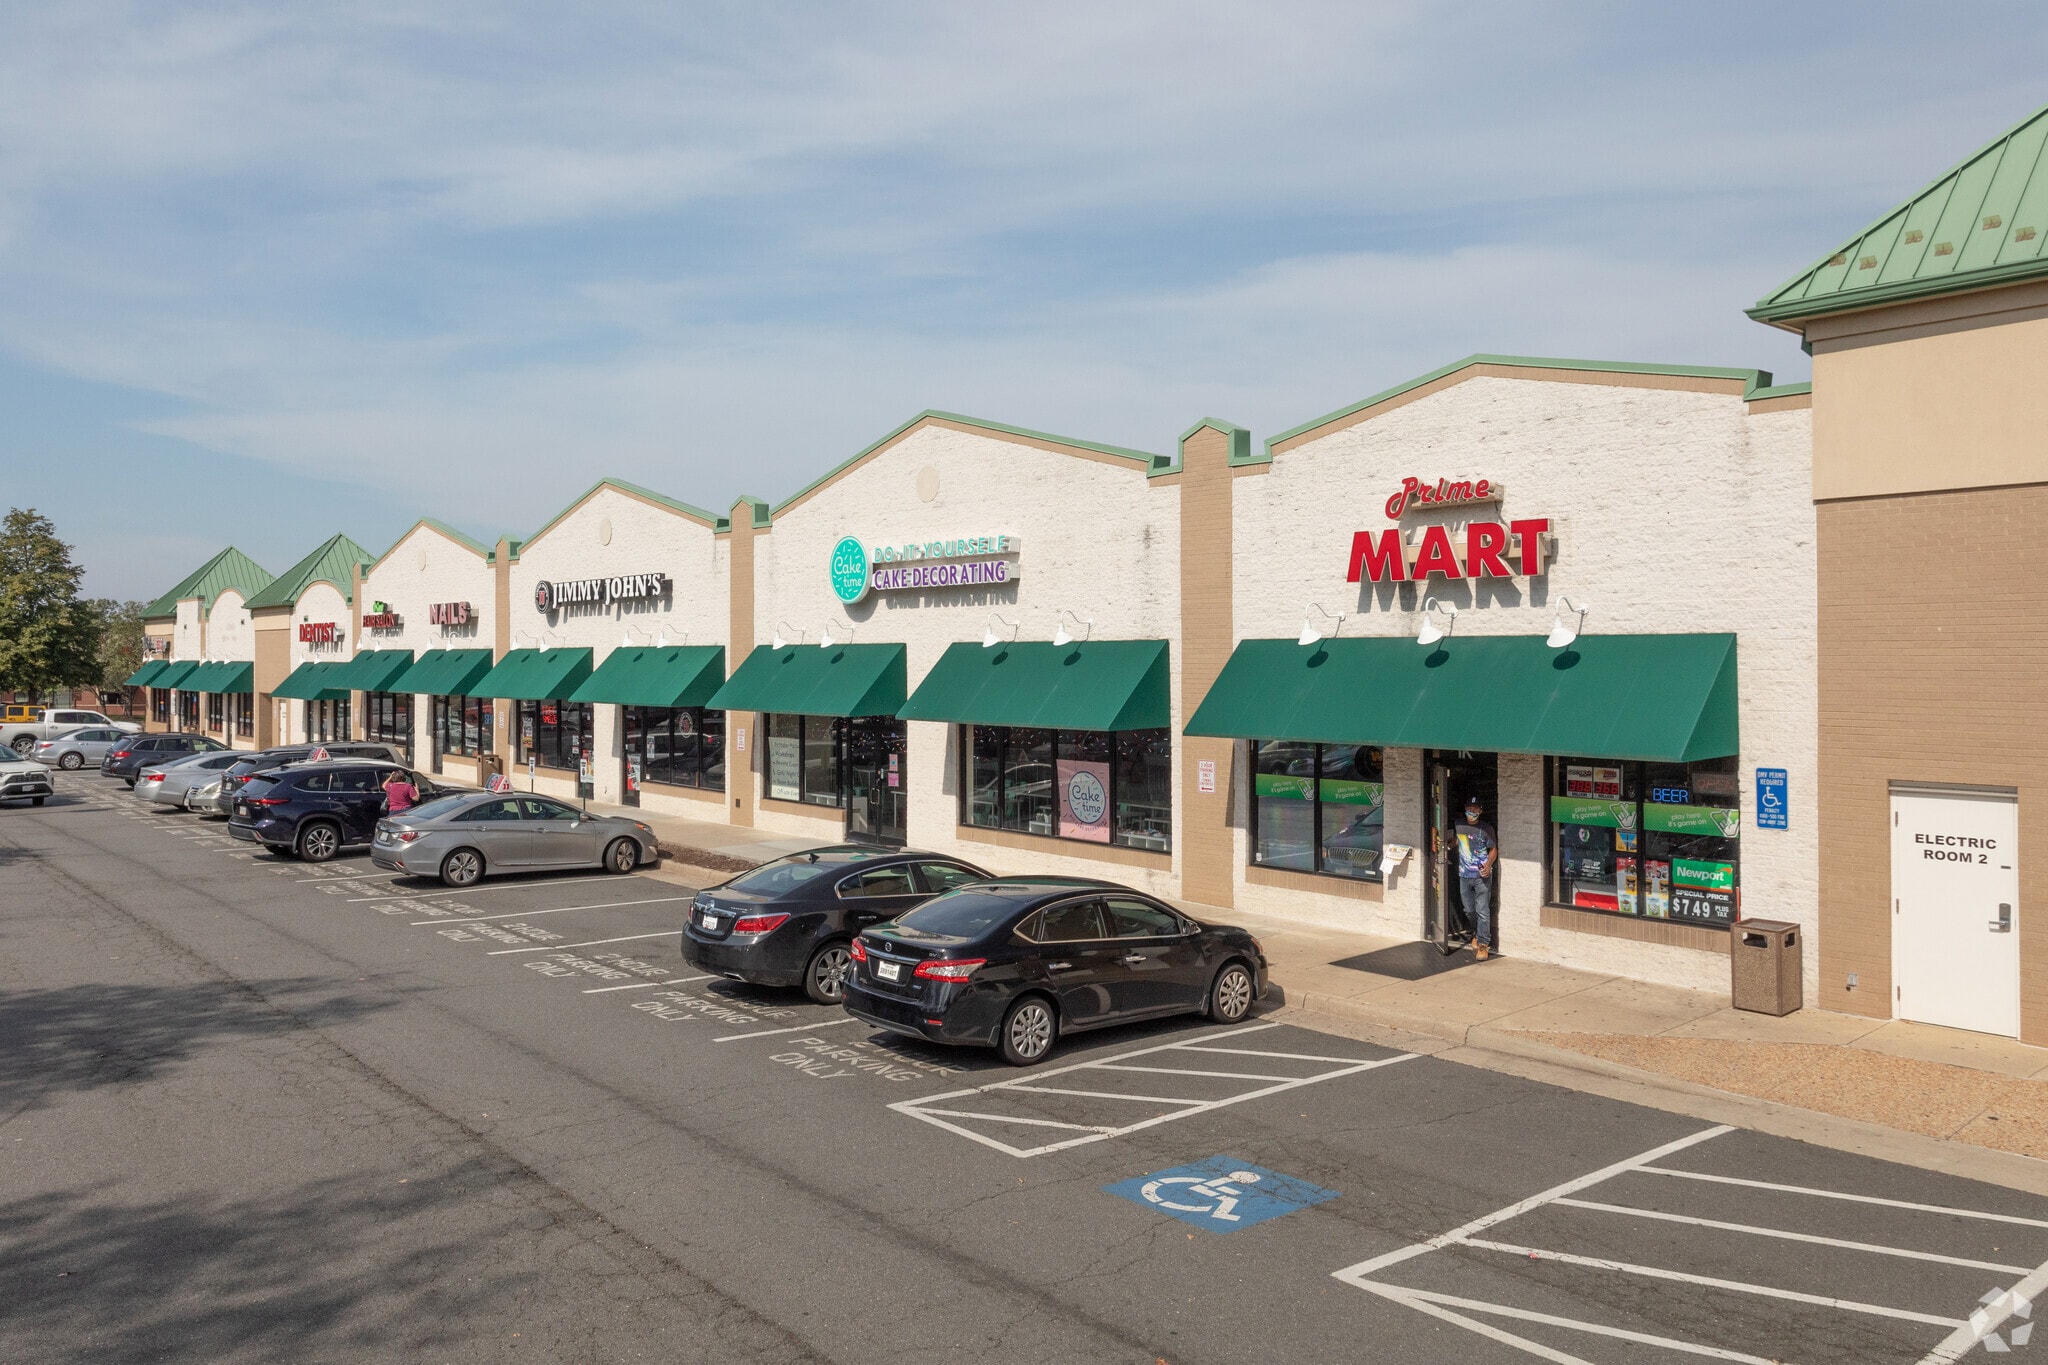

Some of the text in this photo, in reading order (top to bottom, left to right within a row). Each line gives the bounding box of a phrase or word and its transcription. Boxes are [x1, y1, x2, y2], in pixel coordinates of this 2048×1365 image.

[1385, 476, 1490, 519] Prime
[874, 535, 1006, 563] DO-IT-YOURSELF
[1347, 518, 1549, 582] MART
[834, 556, 861, 575] Cake
[874, 561, 1006, 590] CAKE DECORATING
[552, 573, 661, 609] JIMMY JOHN'S
[843, 575, 863, 587] time
[429, 601, 467, 625] NAILS
[299, 621, 336, 643] DENTIST
[1072, 784, 1100, 802] Cake
[1696, 778, 1734, 790] OPEN
[1652, 788, 1688, 803] BEER
[1082, 800, 1101, 813] time
[1677, 820, 1697, 828] game
[1915, 833, 1997, 849] ELECTRIC
[1924, 849, 1988, 864] ROOM 2
[1676, 866, 1724, 882] Newport
[1676, 889, 1729, 901] SPECIAL PRICE
[1673, 898, 1710, 918] $7.49
[436, 930, 486, 942] ONLY
[460, 922, 530, 944] PARKING
[512, 926, 564, 940] HOUR
[523, 962, 582, 978] ONLY
[547, 953, 632, 980] PARKING
[608, 958, 670, 976] HOUR
[630, 1002, 701, 1022] ONLY
[653, 991, 759, 1024] PARKING
[724, 998, 800, 1019] HOUR
[768, 1052, 857, 1080] ONLY
[788, 1037, 924, 1082] PARKING
[873, 1045, 970, 1078] HOUR
